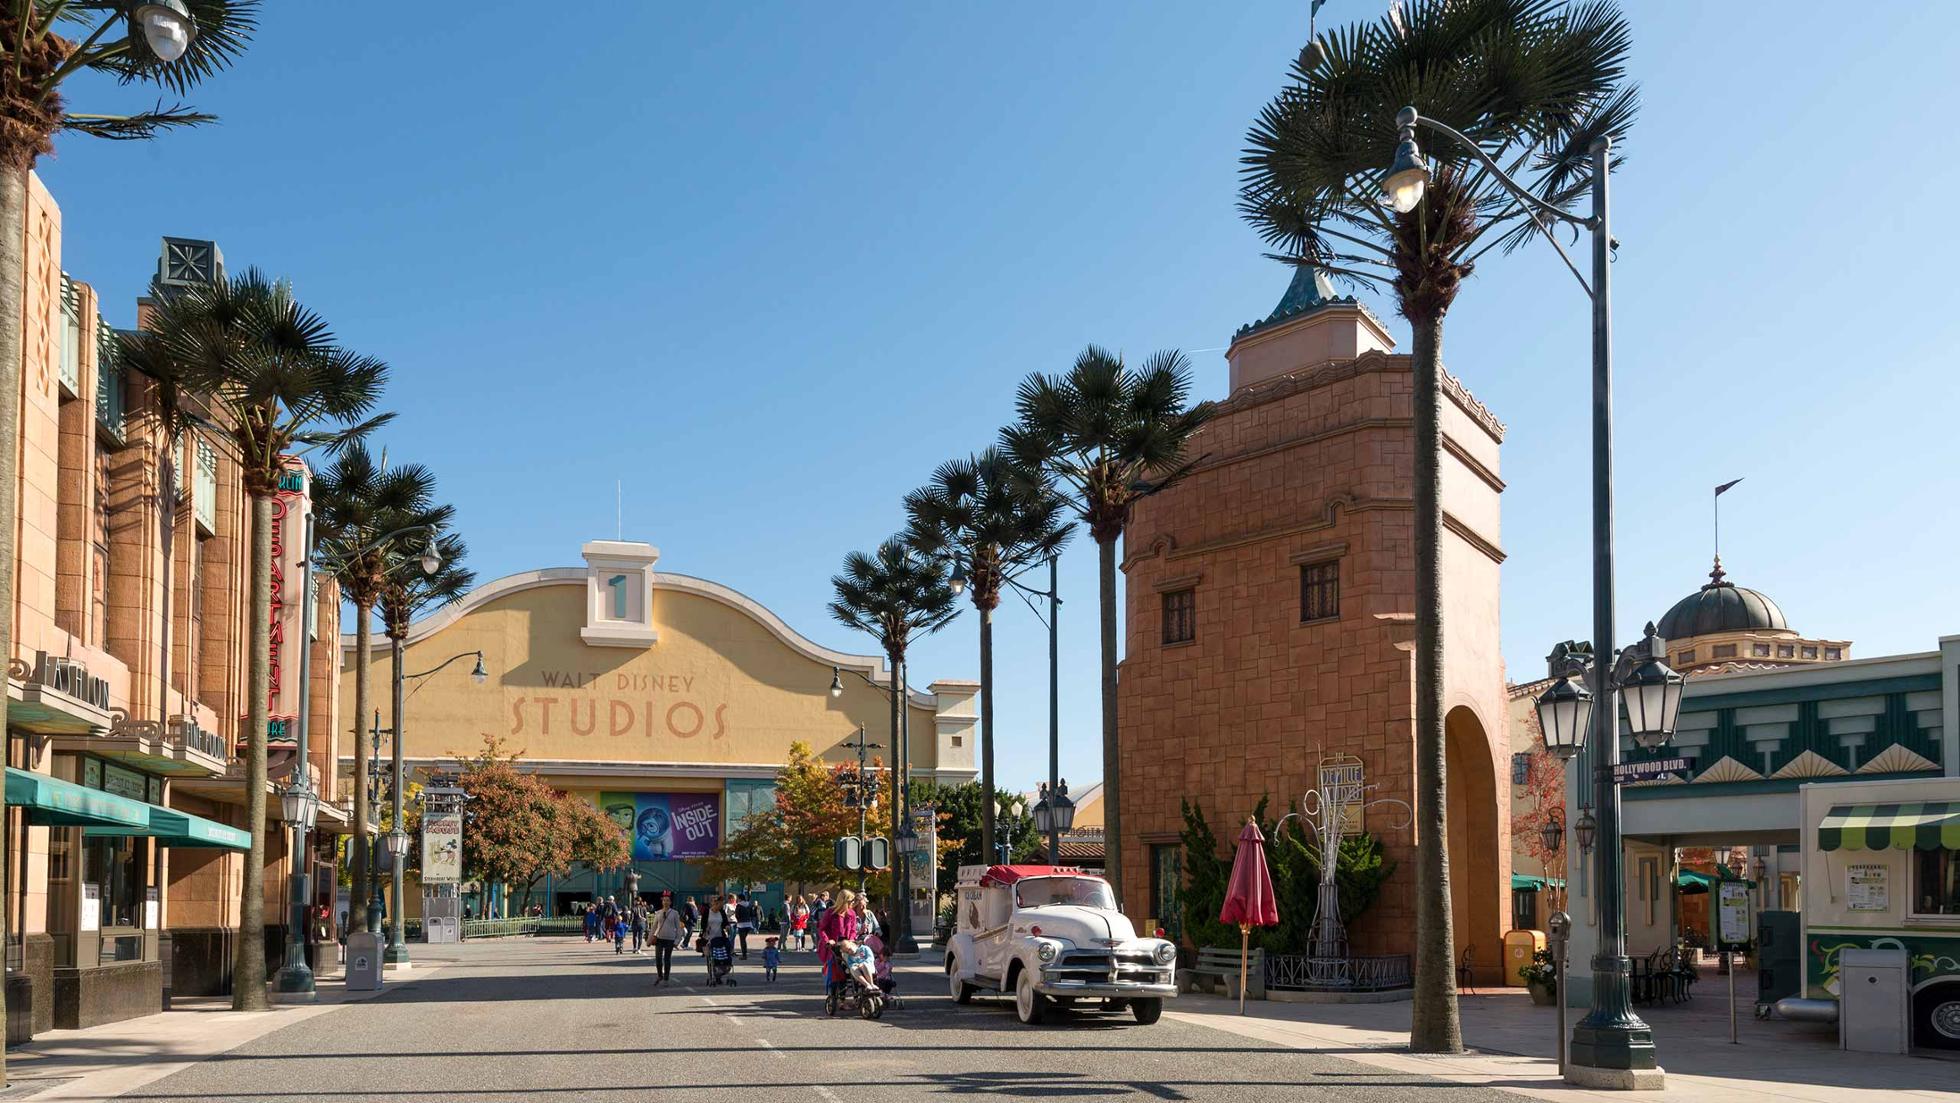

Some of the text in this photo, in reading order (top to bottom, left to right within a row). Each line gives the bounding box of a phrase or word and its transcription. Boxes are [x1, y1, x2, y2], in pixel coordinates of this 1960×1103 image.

[45, 655, 110, 711] FASHION
[541, 670, 694, 692] WALT DISNEY
[511, 697, 728, 740] STUDIOS
[1614, 759, 1687, 776] HOLLYWOOD BLVD.
[671, 804, 717, 831] INSIDE
[685, 819, 713, 841] OUT
